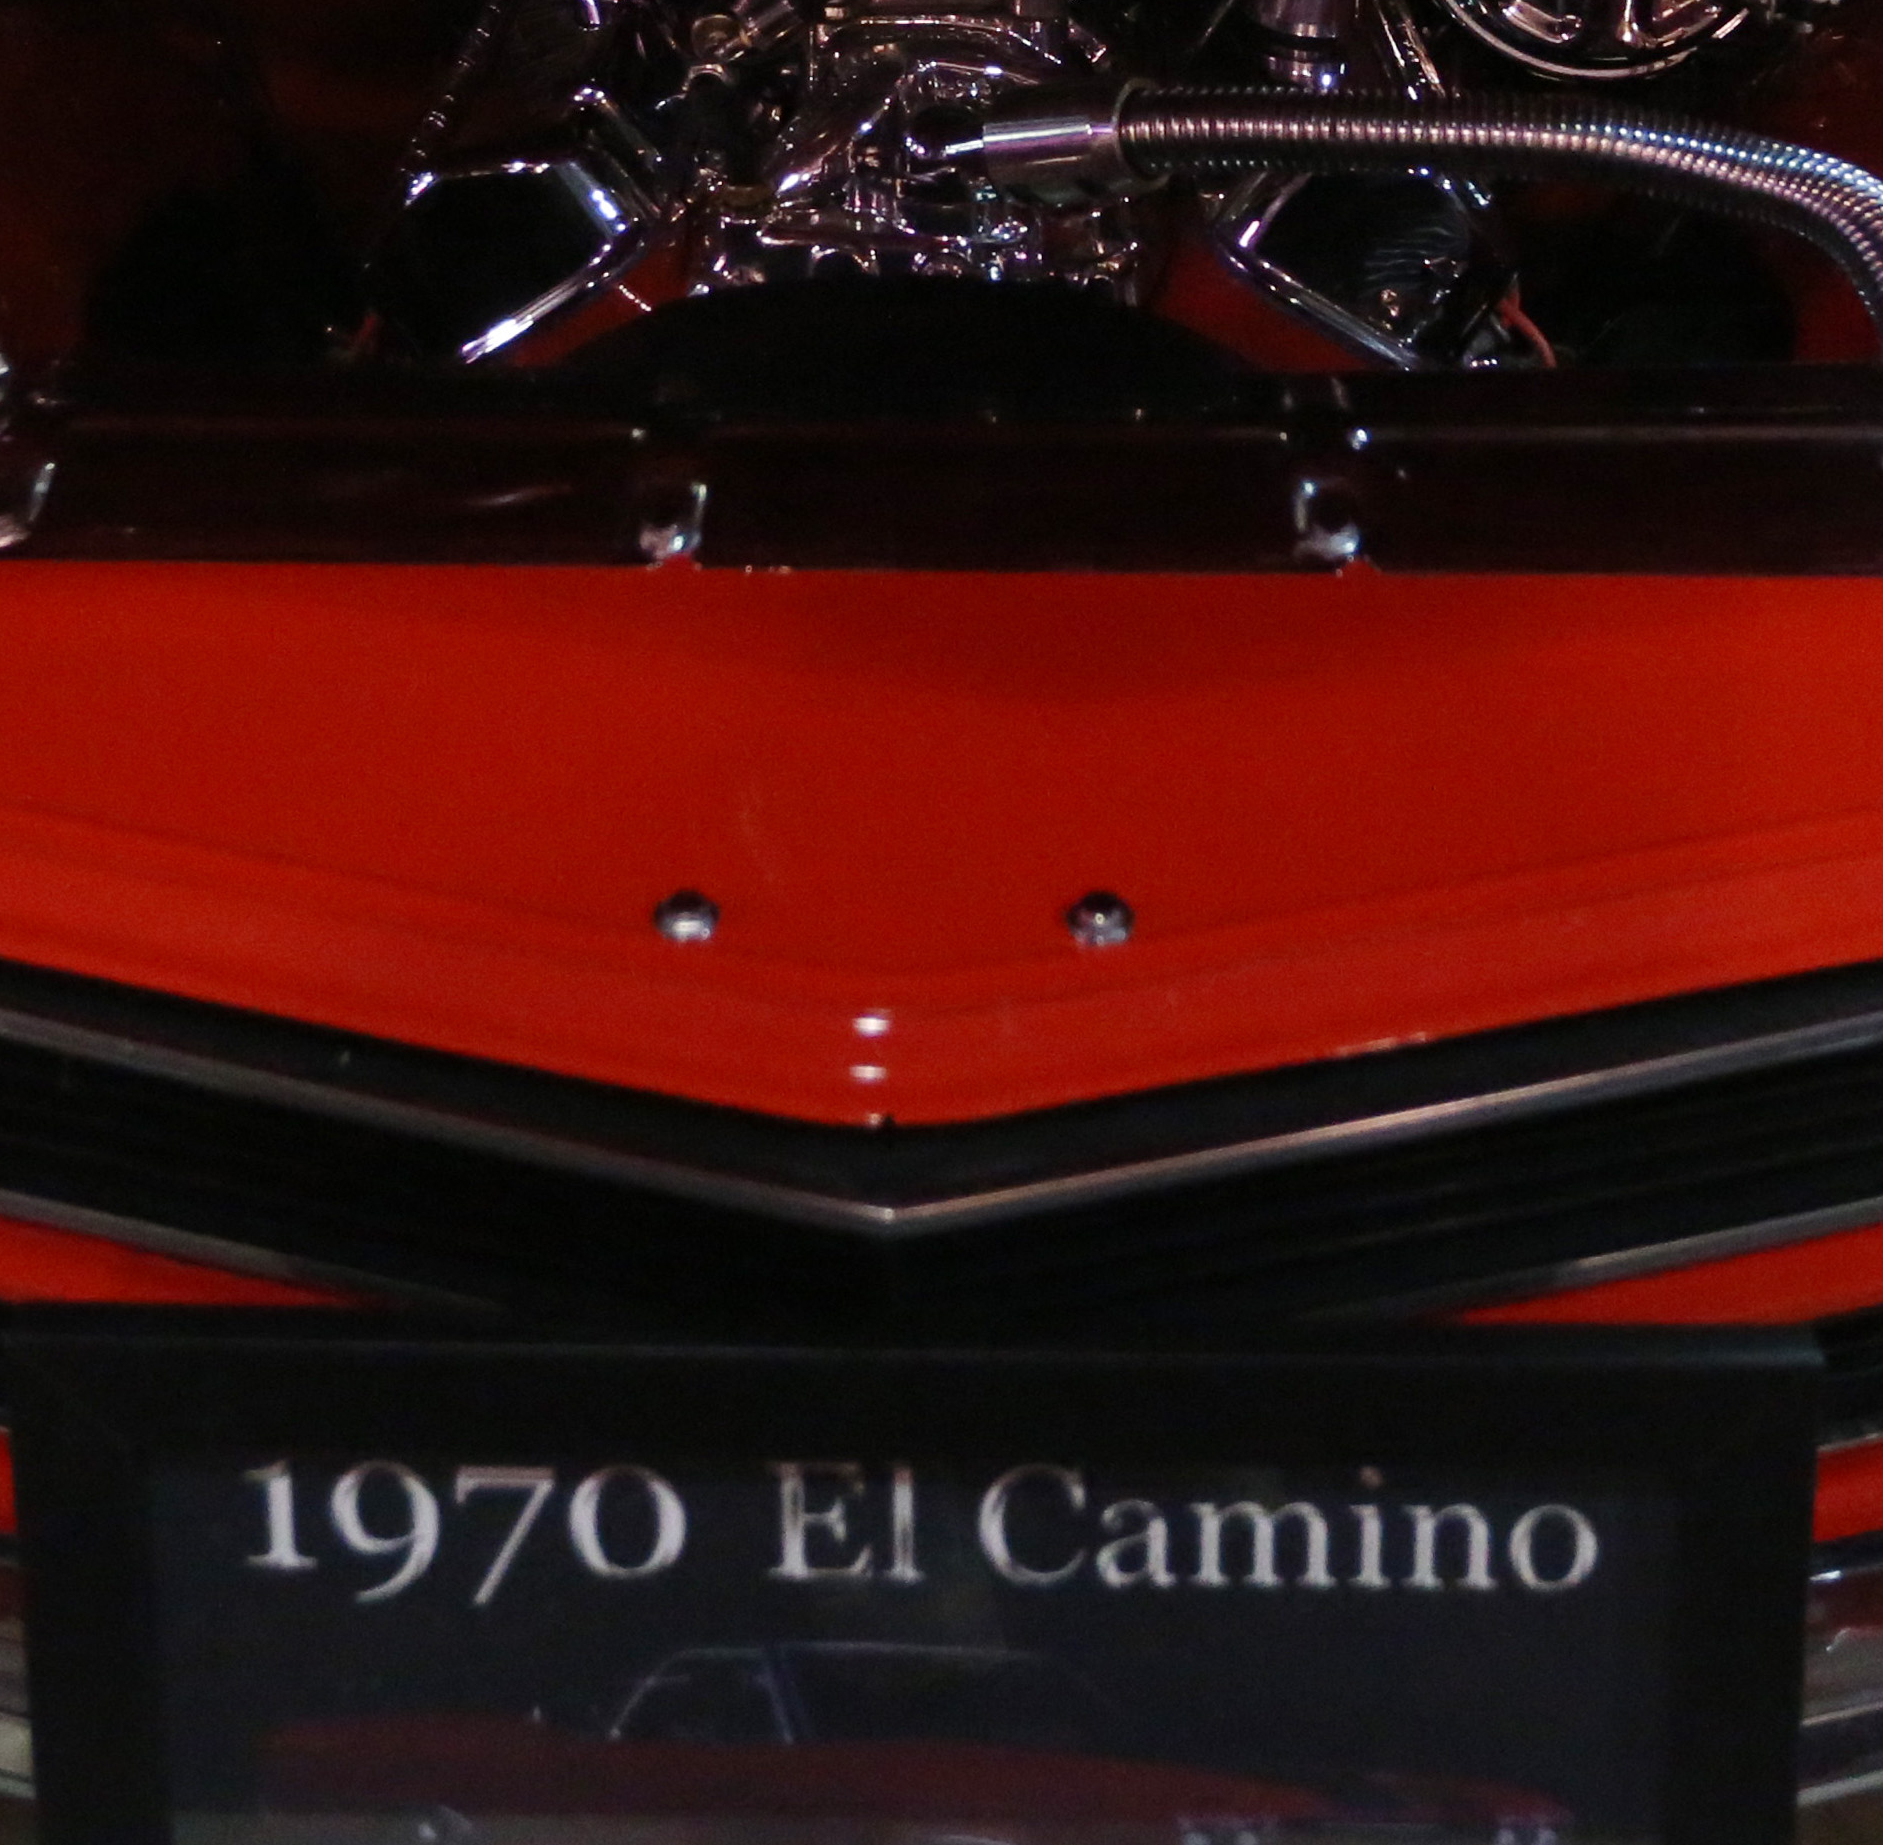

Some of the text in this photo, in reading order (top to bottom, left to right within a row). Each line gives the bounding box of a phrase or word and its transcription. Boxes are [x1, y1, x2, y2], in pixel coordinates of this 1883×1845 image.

[241, 1458, 1600, 1609] 1970 El Camino
